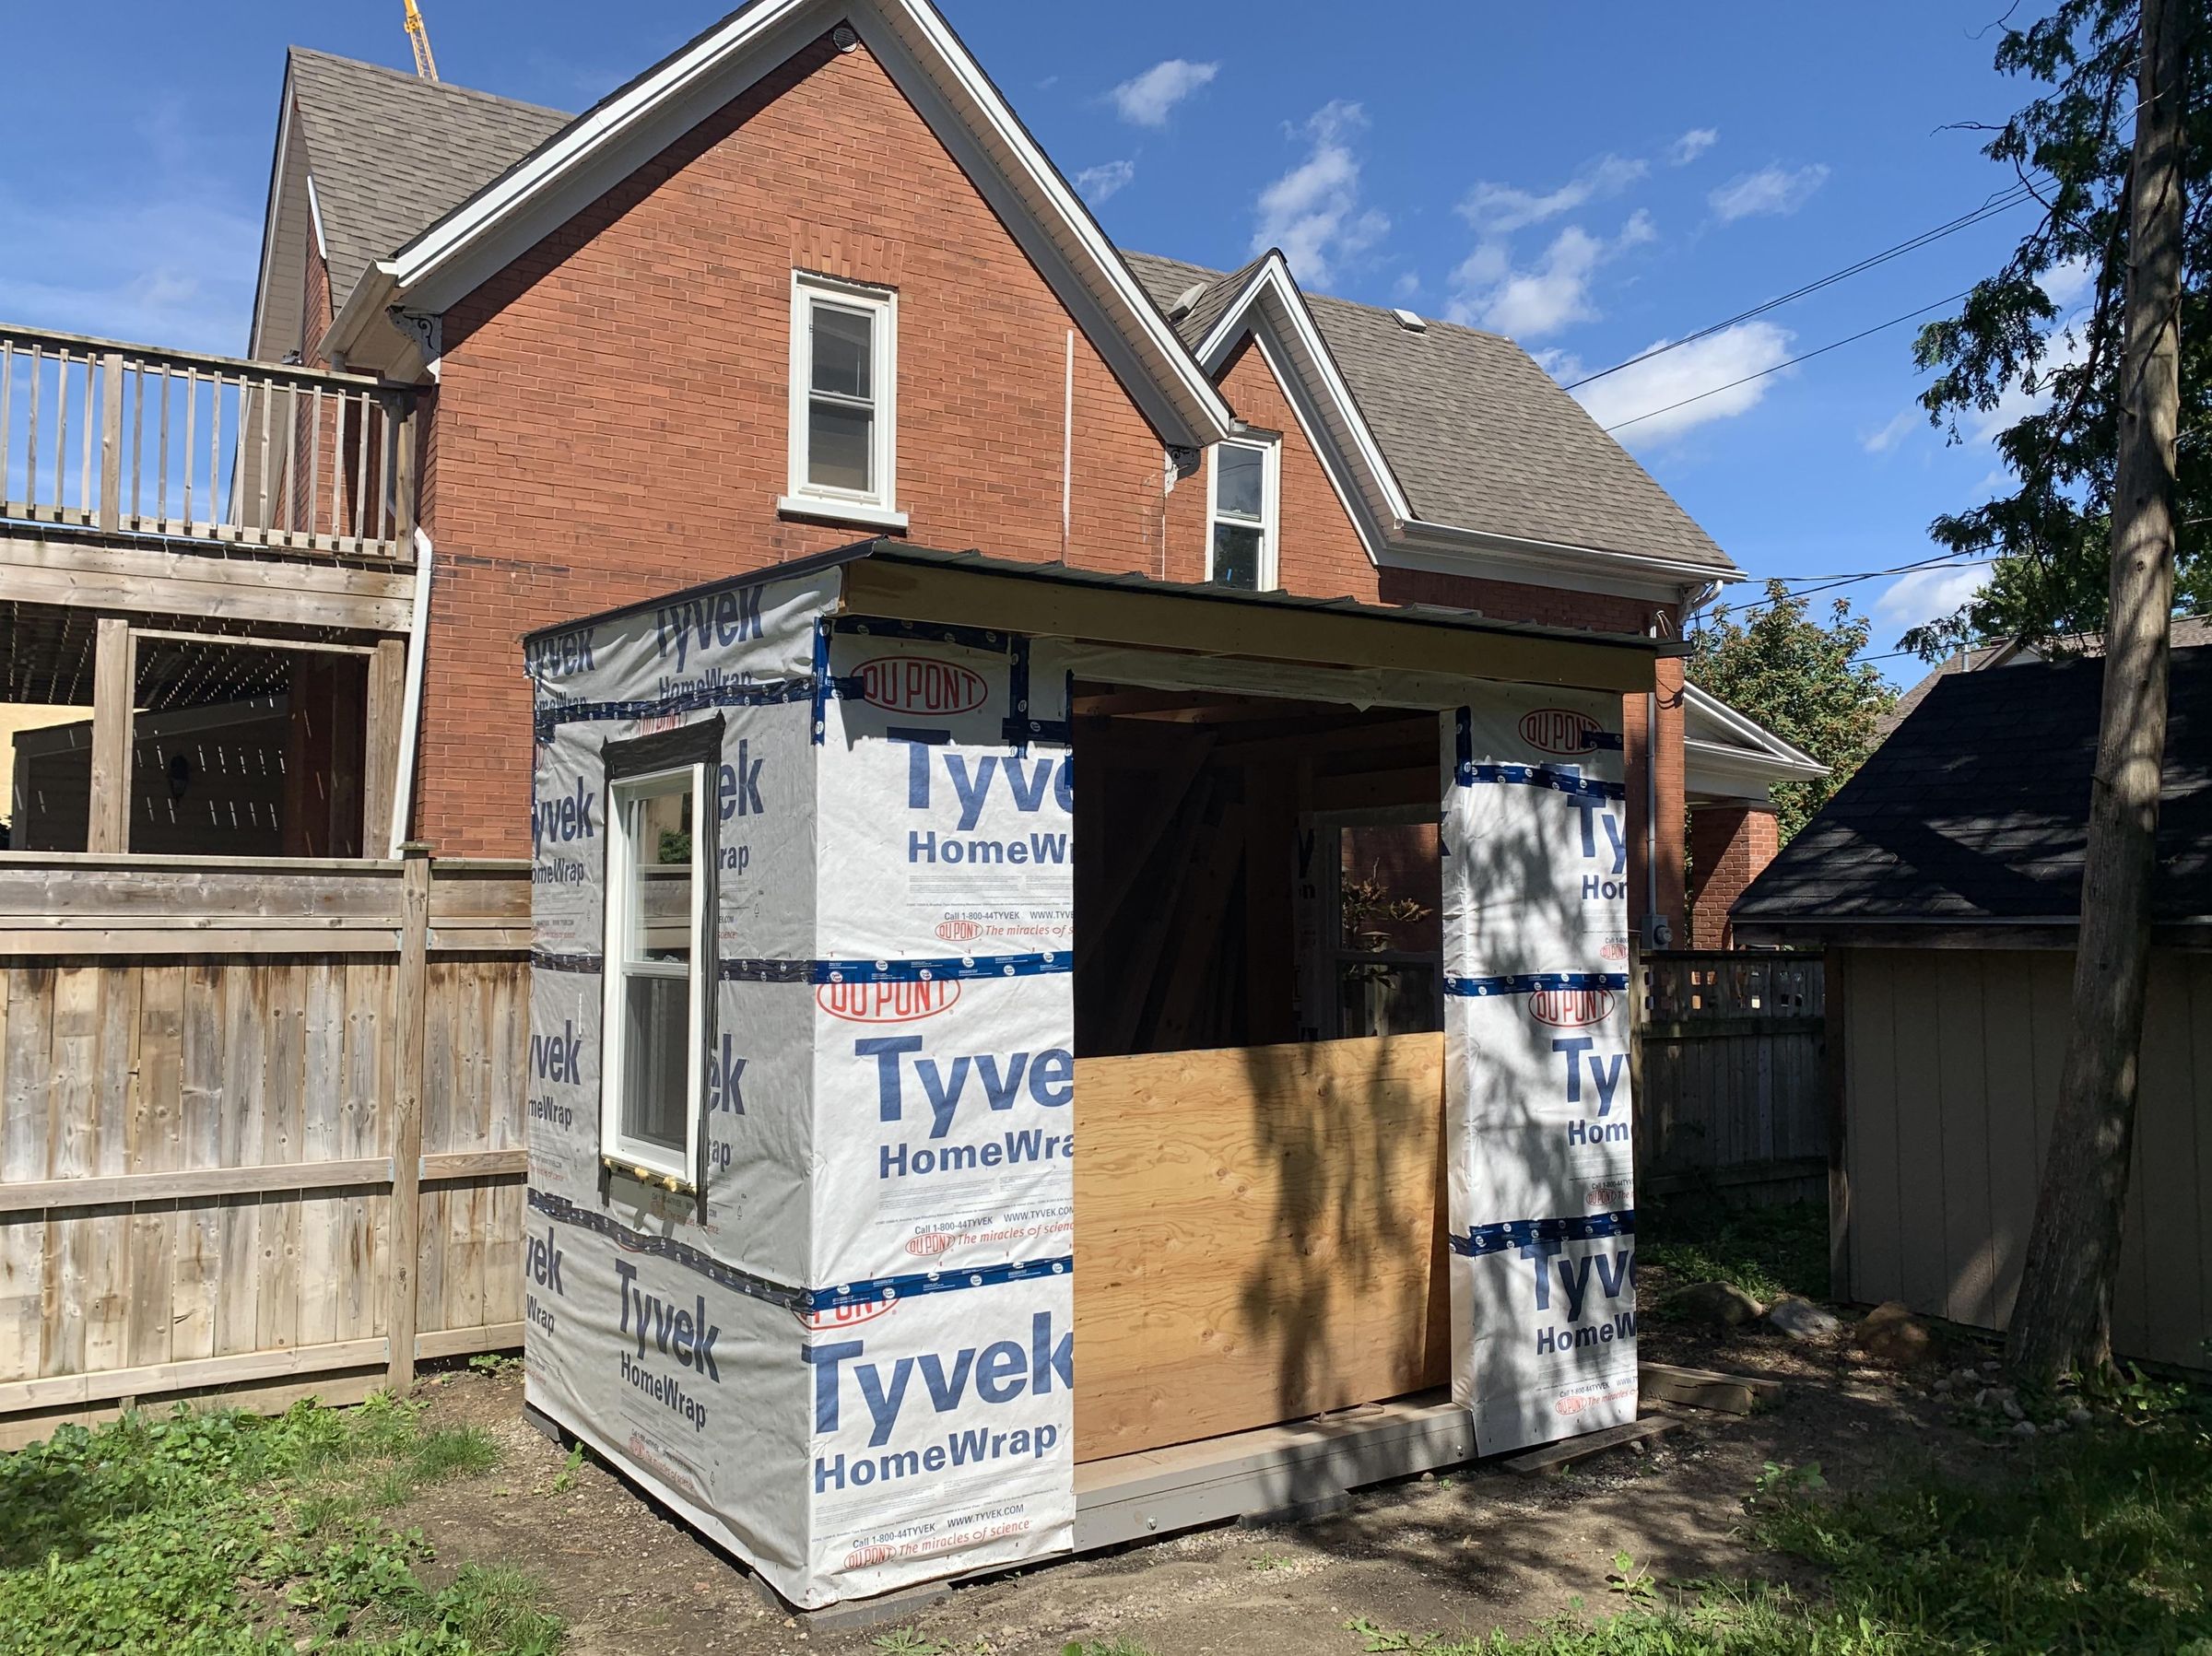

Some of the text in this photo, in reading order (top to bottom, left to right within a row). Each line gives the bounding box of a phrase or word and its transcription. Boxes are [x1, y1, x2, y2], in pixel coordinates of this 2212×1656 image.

[908, 831, 1073, 864] HomeW
[945, 911, 959, 921] Call
[961, 910, 1020, 921] 1-800-44TYVEK
[985, 925, 1004, 936] The
[1007, 924, 1050, 936] miracles
[1053, 925, 1066, 938] of
[1552, 1037, 1630, 1117] Ty
[1569, 1120, 1631, 1146] Hom
[914, 1225, 931, 1235] Call
[933, 1216, 994, 1232] 1-800-44TYVEK
[958, 1234, 977, 1246] The
[980, 1227, 1025, 1243] miracles
[1028, 1226, 1041, 1239] of
[1521, 1245, 1635, 1322] Tyv
[615, 1258, 721, 1383] Tyvek
[620, 1349, 707, 1432] HomeWrap
[802, 1311, 1073, 1449] Tyvek
[815, 1423, 1058, 1494] HomeWrap
[853, 1536, 869, 1549] Call
[872, 1522, 936, 1545] 1-800-44TYVEK
[947, 1503, 1025, 1528] WWW.TYVEK.COM
[900, 1544, 919, 1557] The
[922, 1533, 971, 1552] miracles
[972, 1528, 988, 1543] of
[991, 1520, 1030, 1538] science
